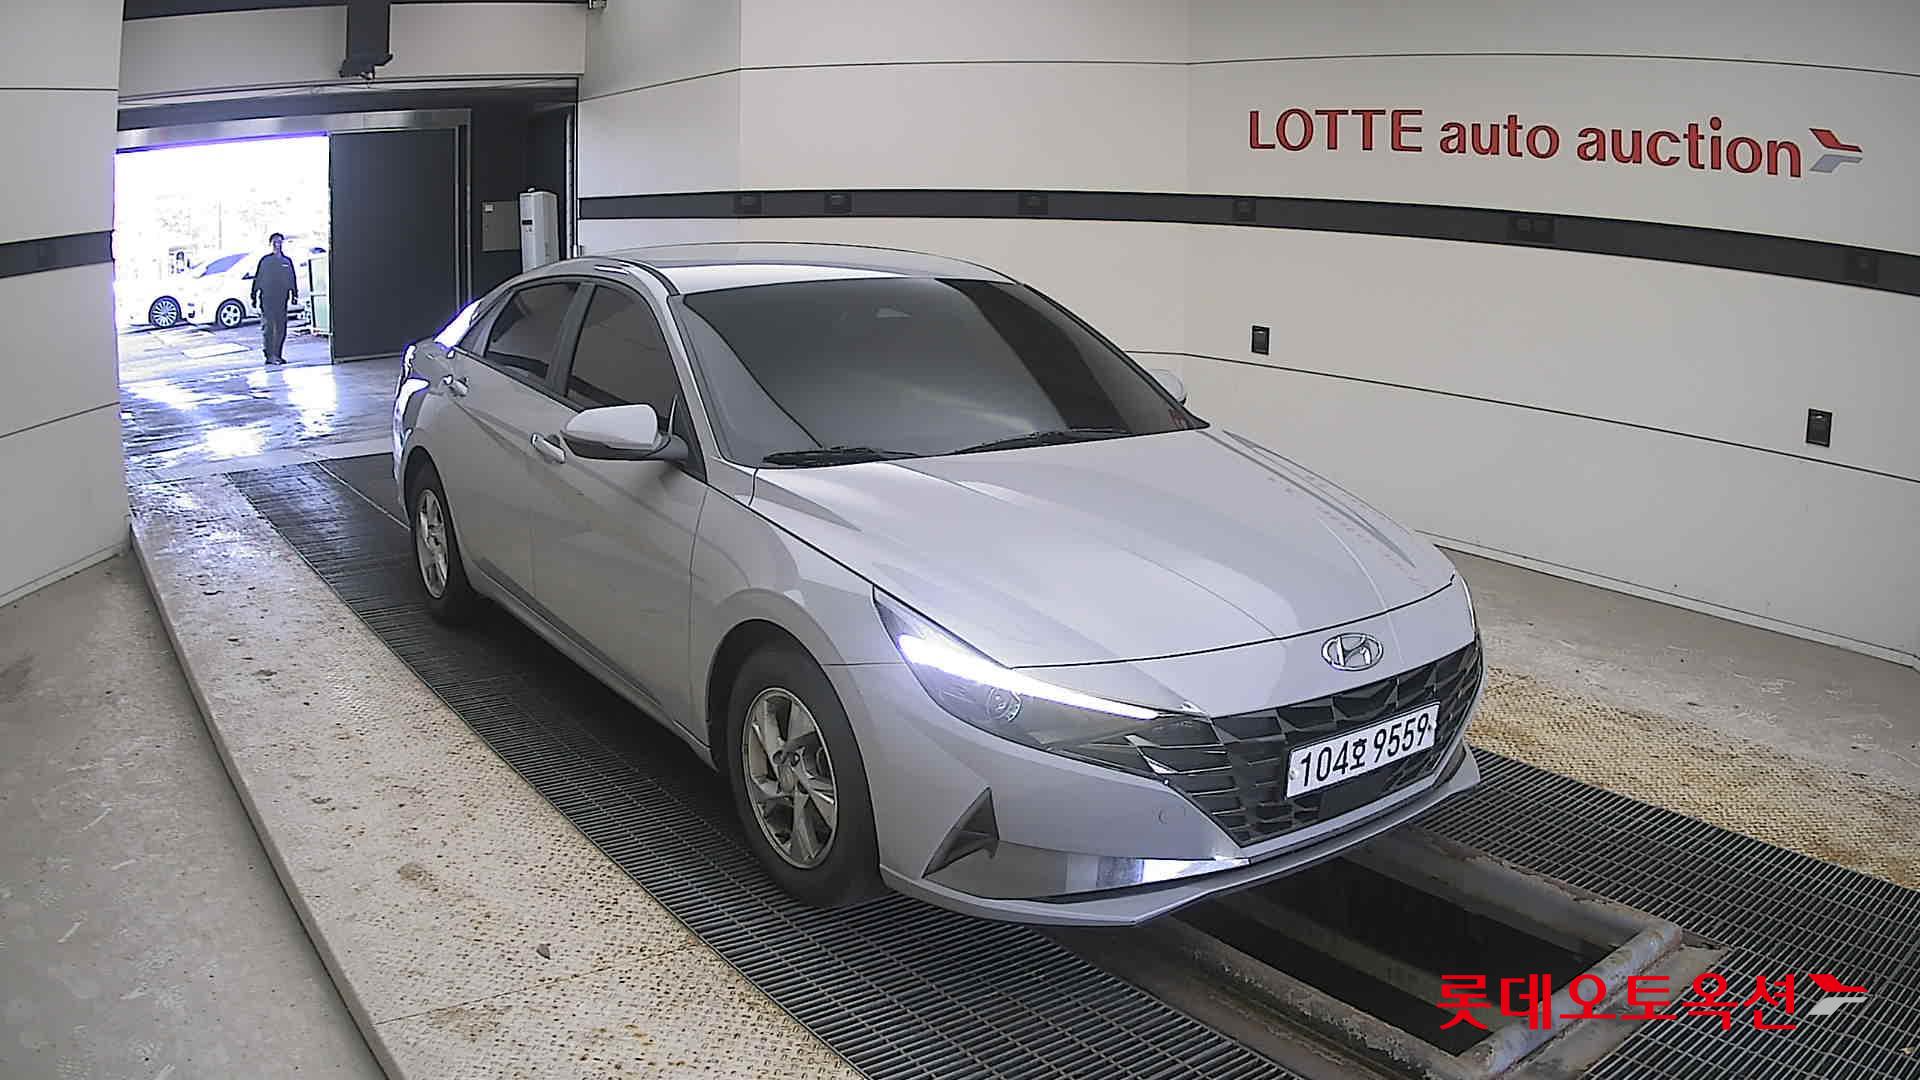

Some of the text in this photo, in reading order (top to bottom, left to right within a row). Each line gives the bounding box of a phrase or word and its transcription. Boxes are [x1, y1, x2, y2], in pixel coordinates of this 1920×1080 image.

[1249, 108, 1802, 178] LOTTE auto auction
[1300, 712, 1430, 787] 104호 9559
